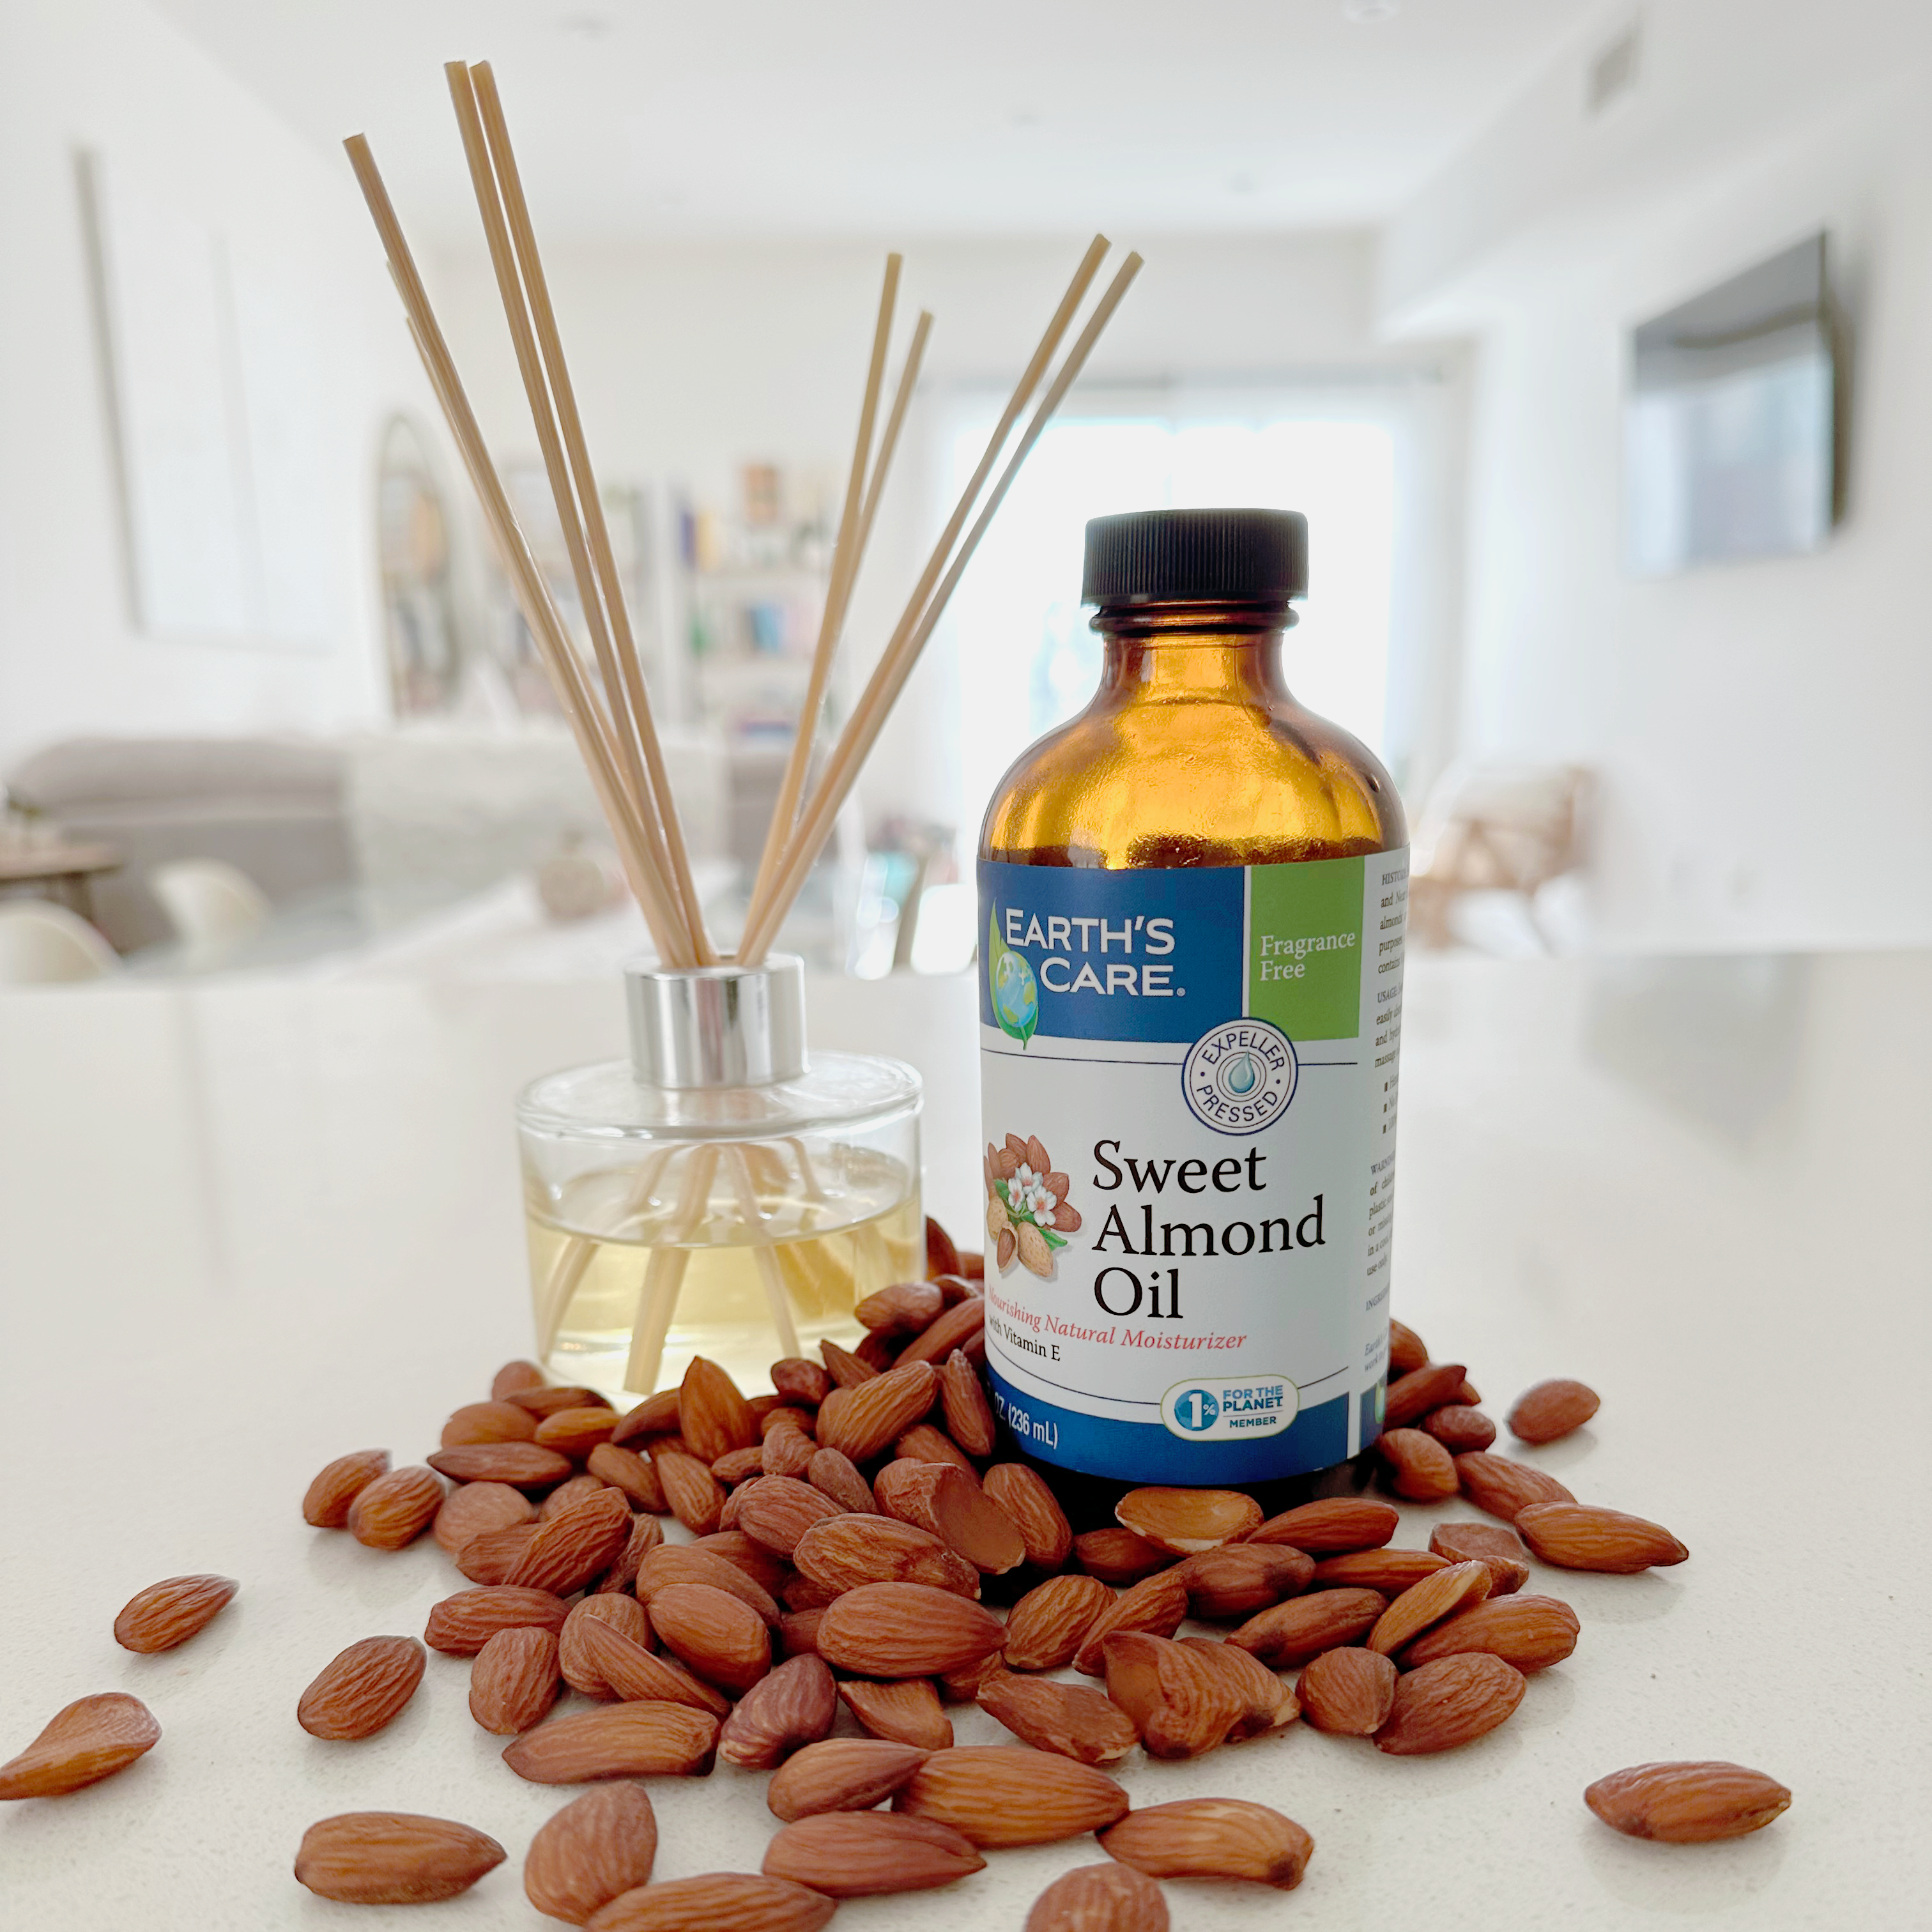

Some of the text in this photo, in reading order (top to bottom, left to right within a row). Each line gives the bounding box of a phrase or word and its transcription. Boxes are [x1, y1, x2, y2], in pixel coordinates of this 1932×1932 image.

[1006, 907, 1176, 955] EARTH'S
[1260, 932, 1356, 960] Fragrance
[1260, 960, 1305, 981] Free
[1201, 1031, 1285, 1071] EXPELLER
[1197, 1084, 1278, 1123] PRESSED
[1092, 1140, 1267, 1193] Sweet
[1092, 1193, 1326, 1257] Almond
[1094, 1266, 1183, 1319] Oil
[988, 1283, 1247, 1350] Nourishing Natural Moisturizer
[988, 1313, 1061, 1361] with Vitamin E
[1223, 1385, 1283, 1400] FOR THE
[1223, 1396, 1284, 1412] PLANET
[1008, 1402, 1030, 1436] (236
[1033, 1420, 1058, 1450] mL)
[1229, 1416, 1276, 1429] MEMBER
